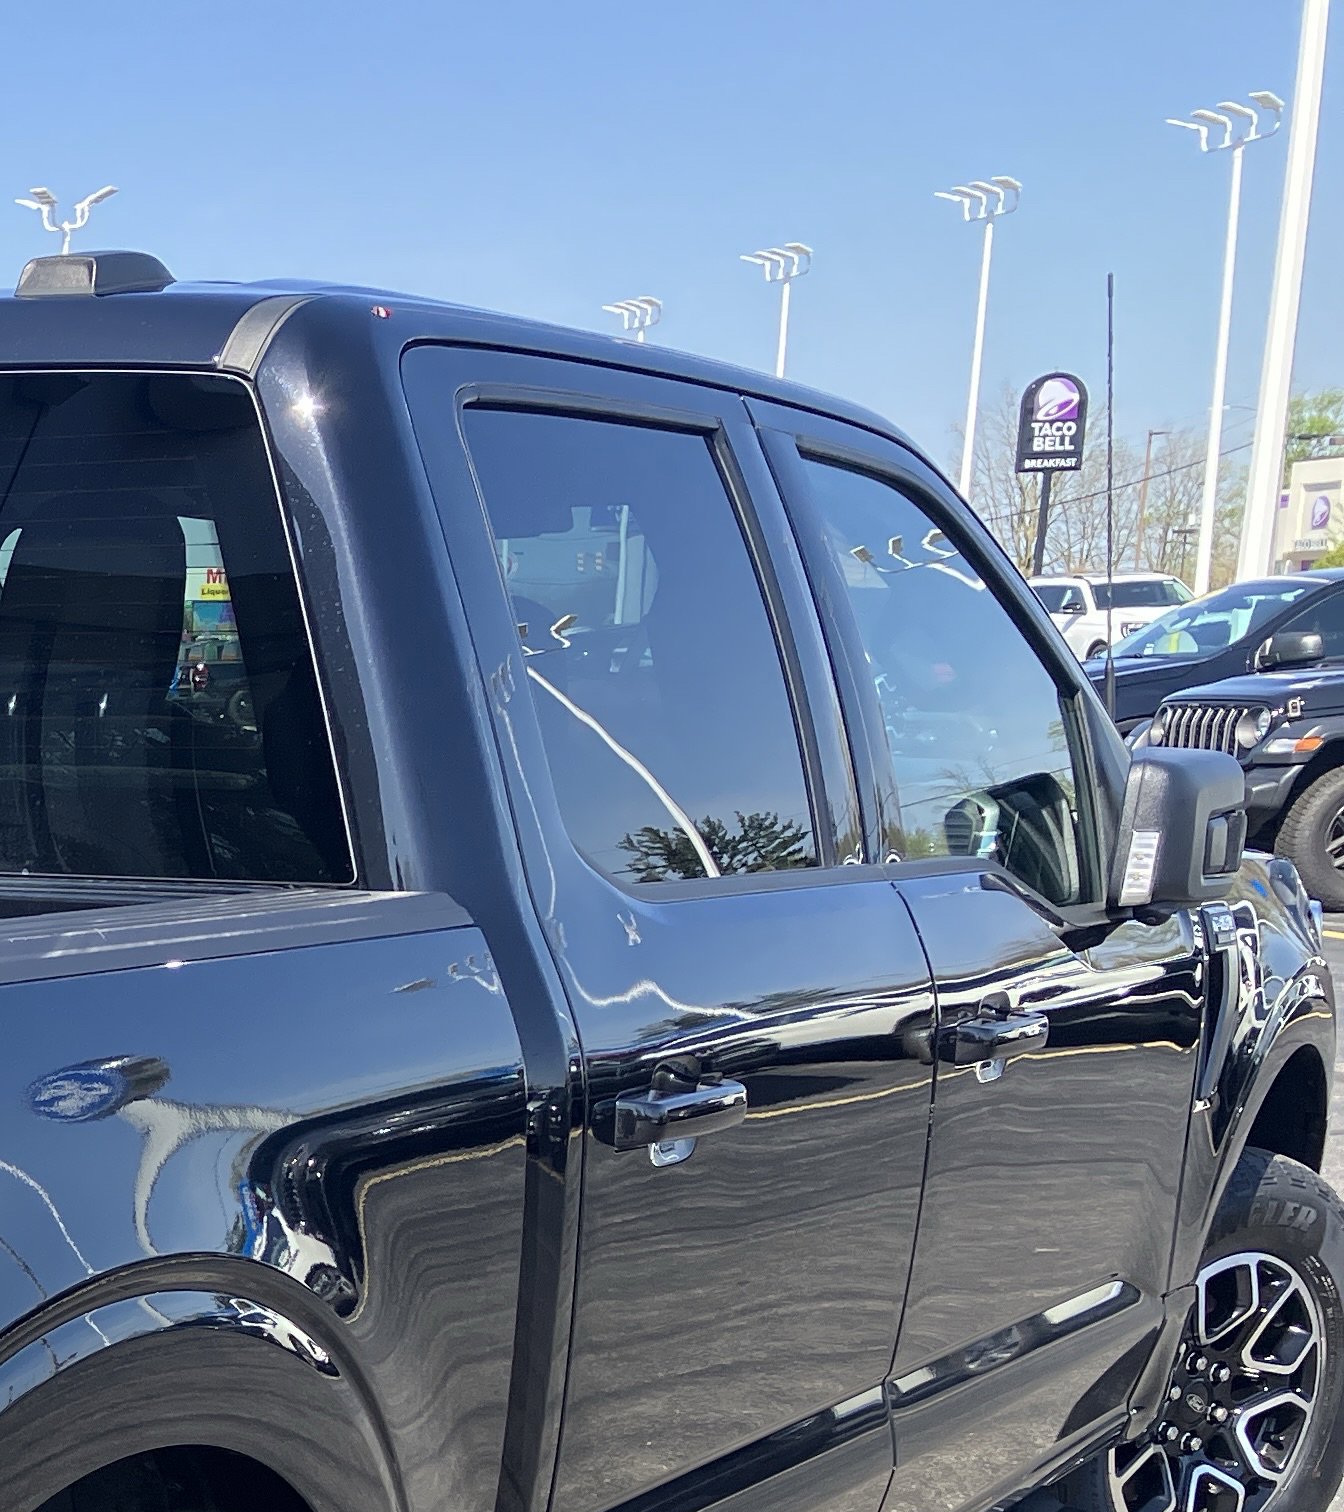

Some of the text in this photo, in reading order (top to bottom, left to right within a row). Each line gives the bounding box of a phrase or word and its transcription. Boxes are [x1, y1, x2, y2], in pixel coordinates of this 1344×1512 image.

[1030, 421, 1077, 437] TACO
[1032, 437, 1075, 452] BELL
[1024, 458, 1078, 469] BREAKFAST
